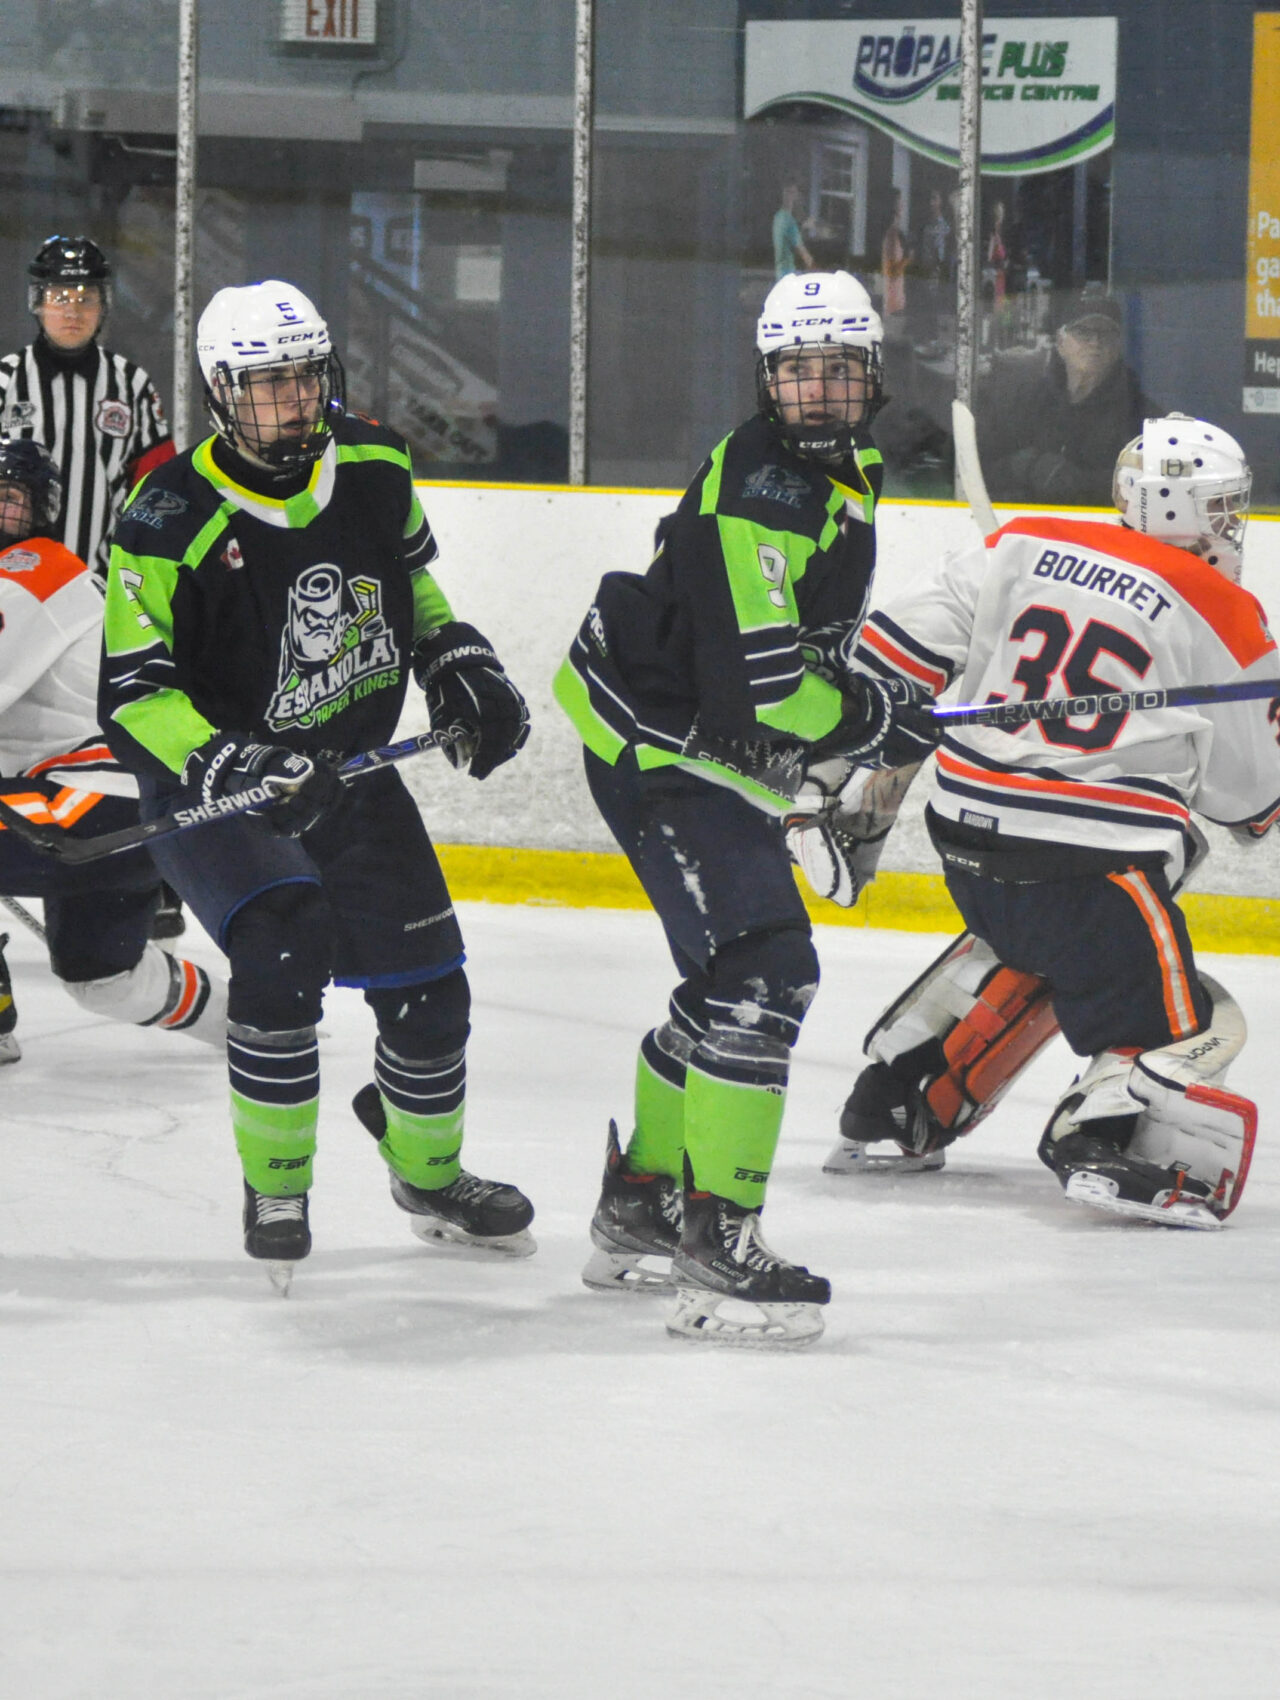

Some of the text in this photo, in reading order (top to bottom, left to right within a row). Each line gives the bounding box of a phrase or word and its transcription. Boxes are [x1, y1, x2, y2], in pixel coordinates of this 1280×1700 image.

[998, 41, 1069, 78] PLUS
[1020, 84, 1099, 101] CENTRE
[804, 282, 821, 296] 9
[276, 302, 298, 320] 5
[791, 317, 834, 328] CCM
[277, 332, 314, 345] CCM
[757, 542, 787, 609] 9
[1032, 549, 1172, 622] BOURRET
[273, 636, 393, 719] ESPANOLA
[983, 603, 1154, 755] 35
[315, 669, 400, 727] PAPER KINGS
[945, 853, 980, 868] CCM
